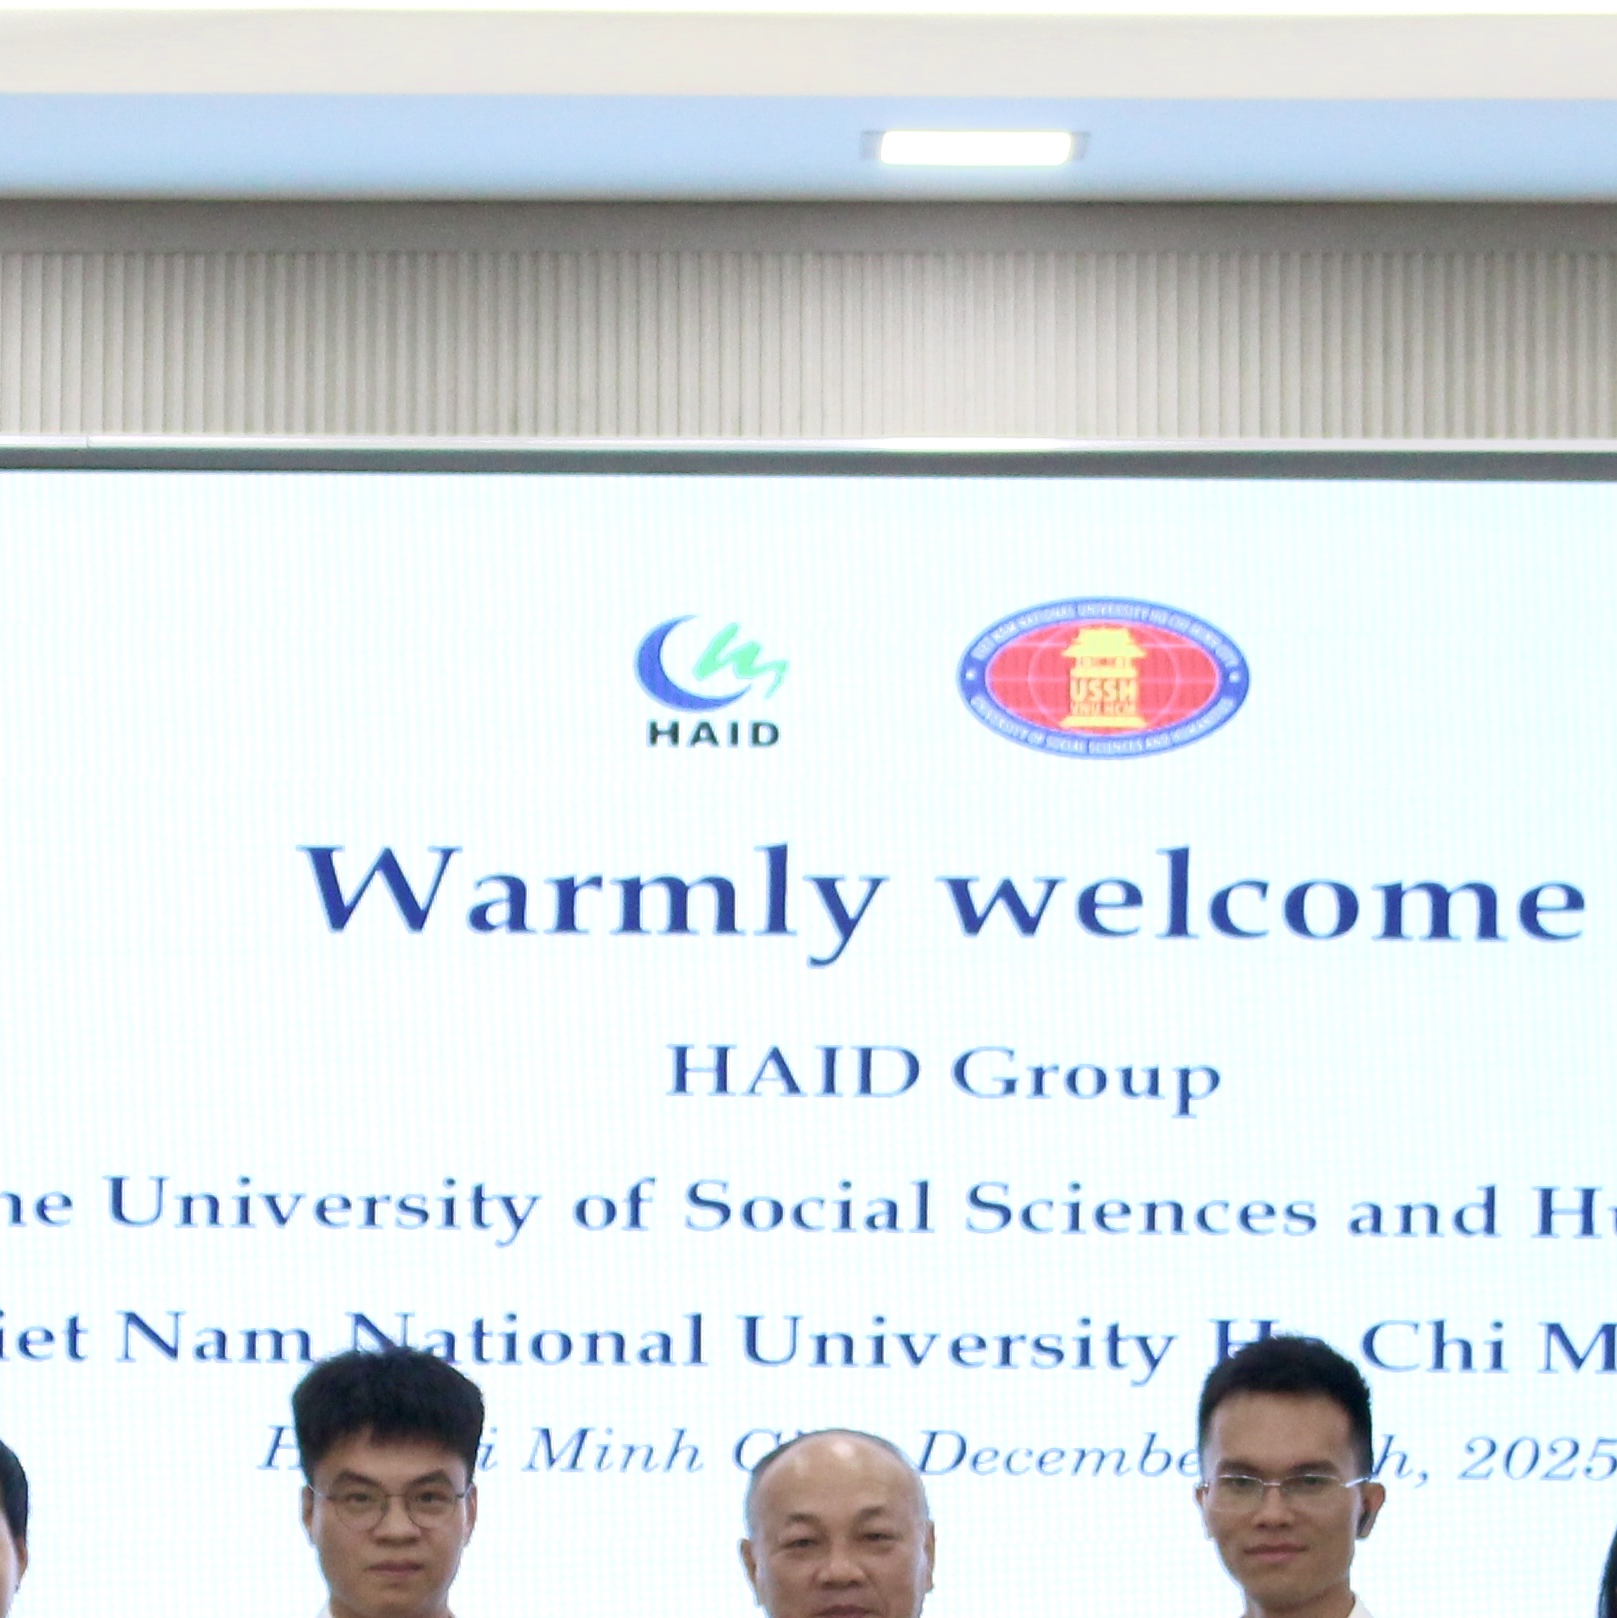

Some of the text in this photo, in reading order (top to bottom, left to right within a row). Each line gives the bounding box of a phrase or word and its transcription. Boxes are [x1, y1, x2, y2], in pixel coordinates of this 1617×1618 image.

[1070, 678, 1138, 701] USSH
[647, 720, 781, 749] HAID
[297, 842, 1587, 970] Warmly welcome
[667, 1044, 1223, 1120] HAID Group
[103, 1174, 543, 1249] University
[573, 1176, 658, 1232] of
[686, 1178, 936, 1234] Social
[967, 1181, 1319, 1238] Sciences
[1348, 1184, 1503, 1239] and
[117, 1310, 313, 1365] Nam
[346, 1312, 709, 1366] National
[737, 1315, 1180, 1389] University
[1360, 1319, 1511, 1375] Chi
[522, 1428, 705, 1474] Minh
[918, 1429, 1202, 1478] Decembe
